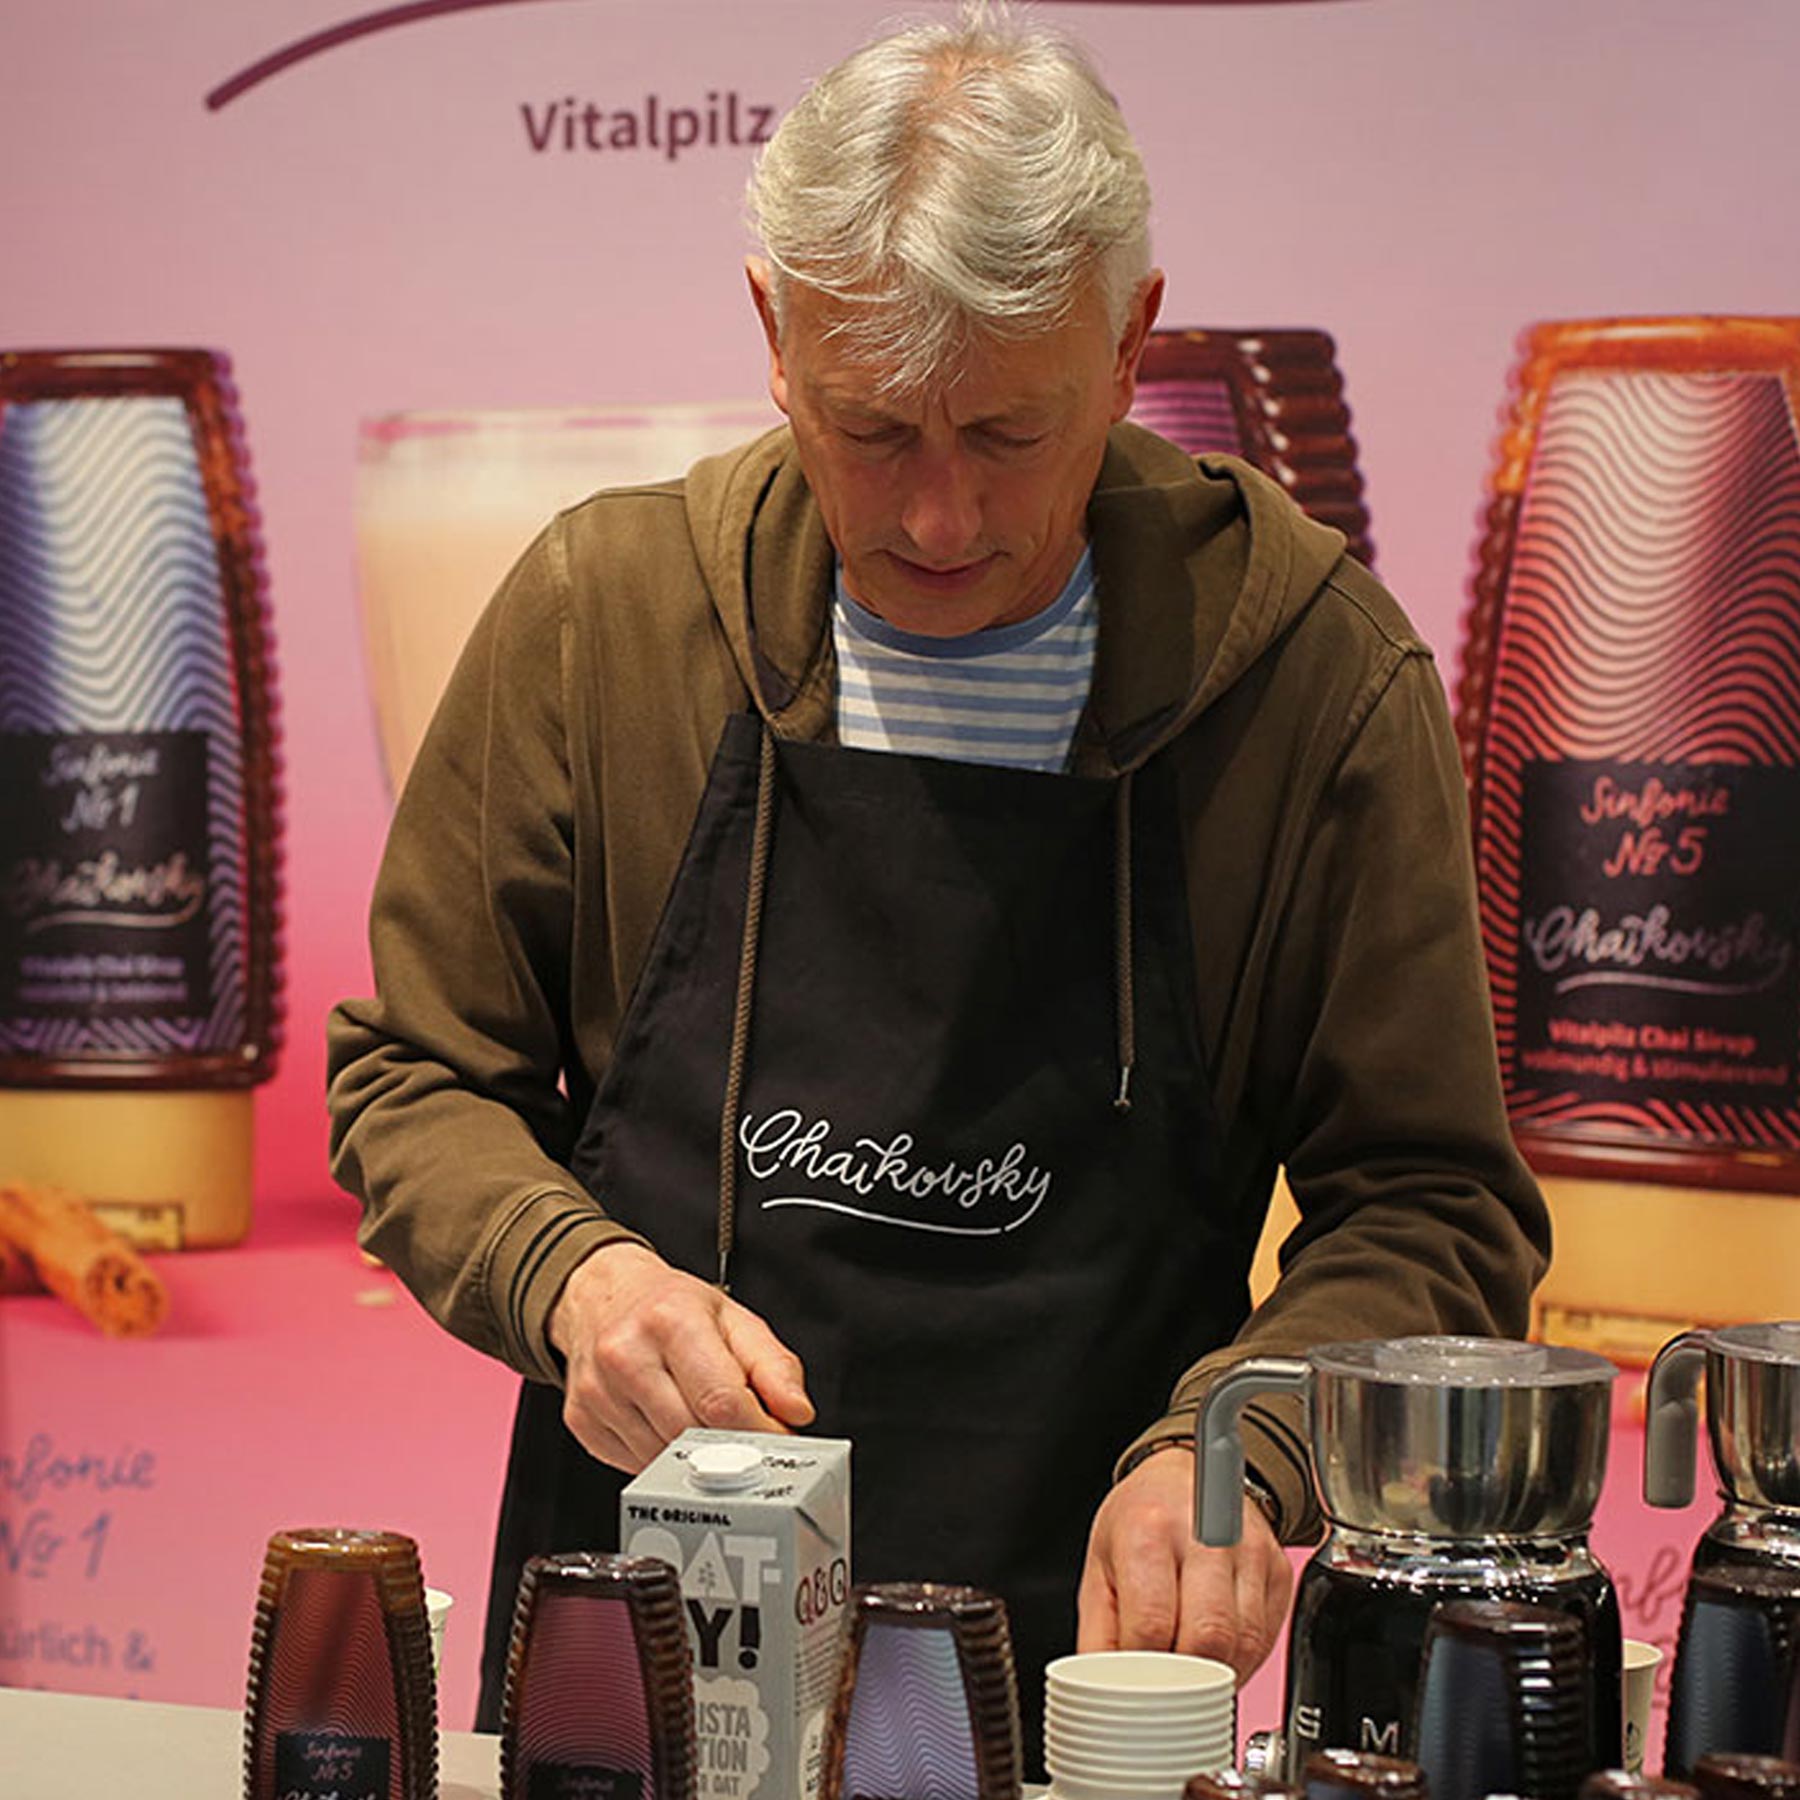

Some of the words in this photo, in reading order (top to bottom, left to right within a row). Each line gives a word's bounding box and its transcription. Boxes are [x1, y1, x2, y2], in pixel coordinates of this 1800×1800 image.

[519, 92, 775, 161] Vitalpilz
[1579, 776, 1729, 826] Sinfonie
[1669, 827, 1708, 876] 5
[740, 1109, 1051, 1234] Chaikovsky
[627, 1505, 658, 1522] THE
[661, 1509, 732, 1527] ORIGINAL
[82, 1511, 111, 1579] 1
[124, 1631, 155, 1671] &
